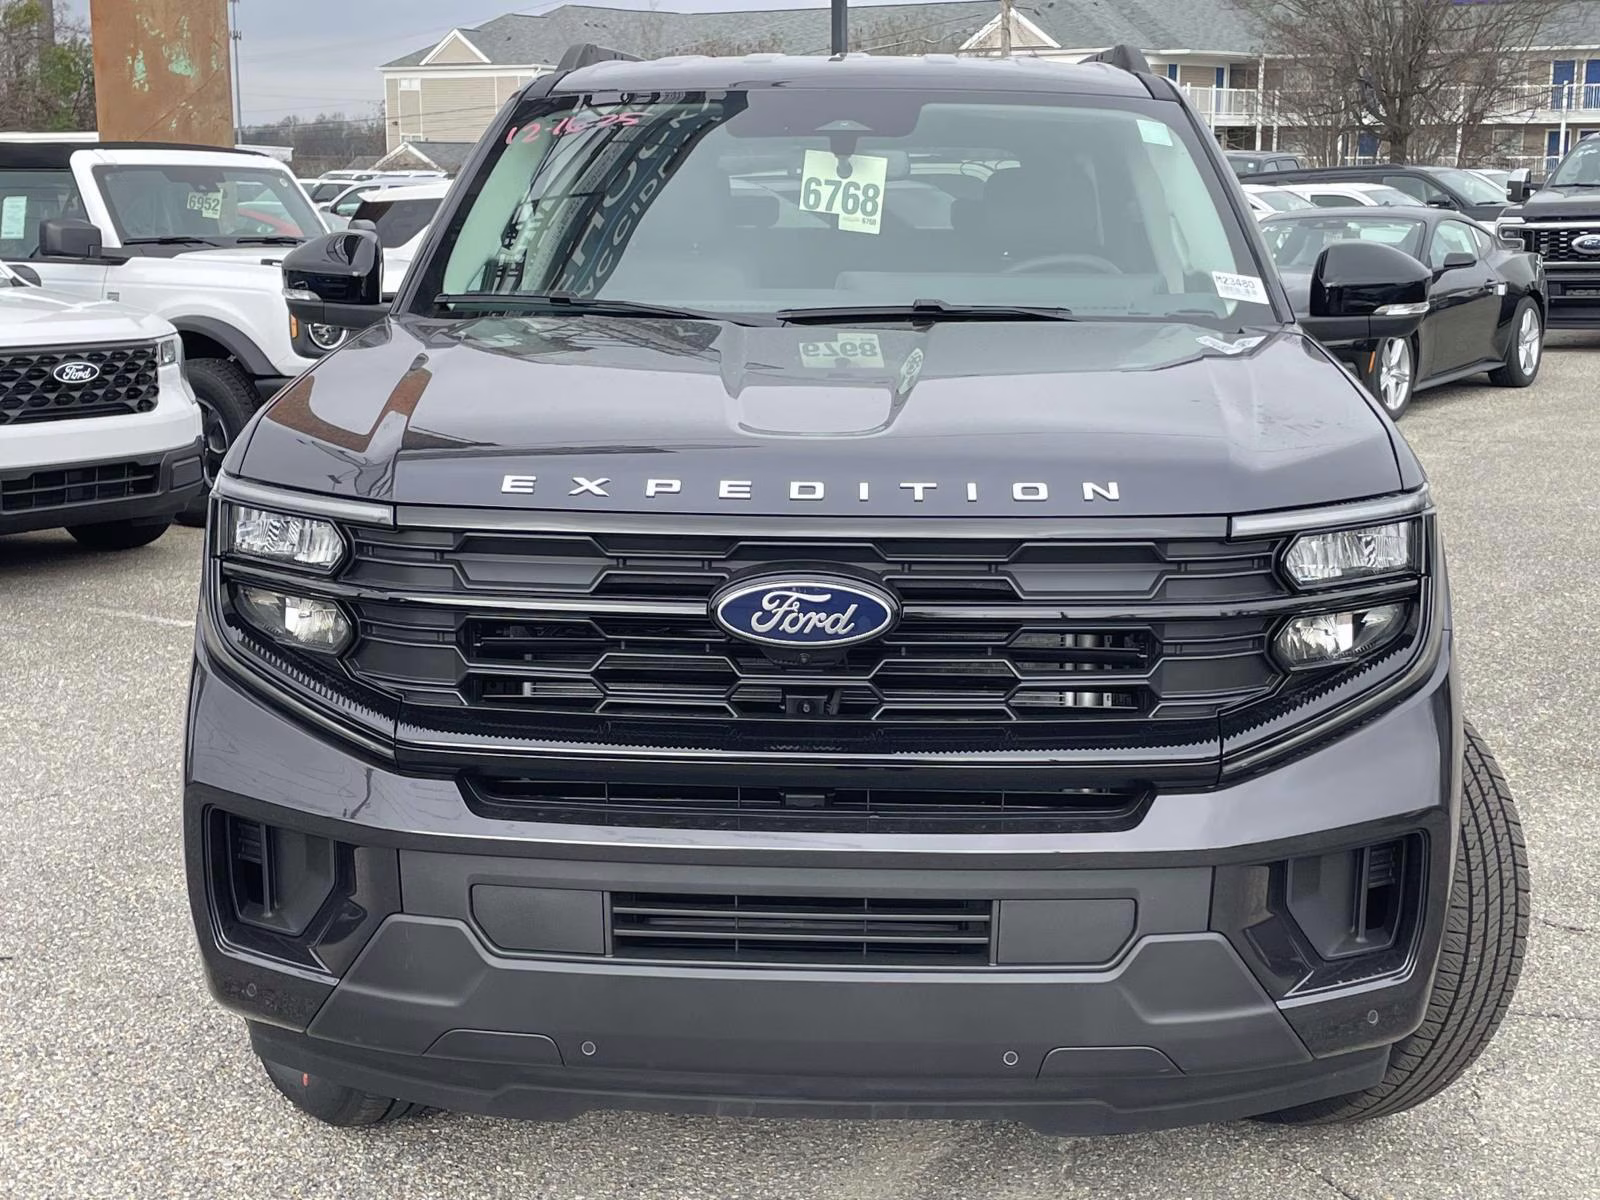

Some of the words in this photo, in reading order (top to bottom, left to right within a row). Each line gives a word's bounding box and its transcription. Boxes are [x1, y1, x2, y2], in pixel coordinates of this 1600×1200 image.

[189, 195, 220, 211] 6952
[803, 177, 880, 217] 6768
[62, 365, 91, 380] Ford
[501, 474, 1119, 501] EXPEDITION
[751, 590, 858, 635] Ford
